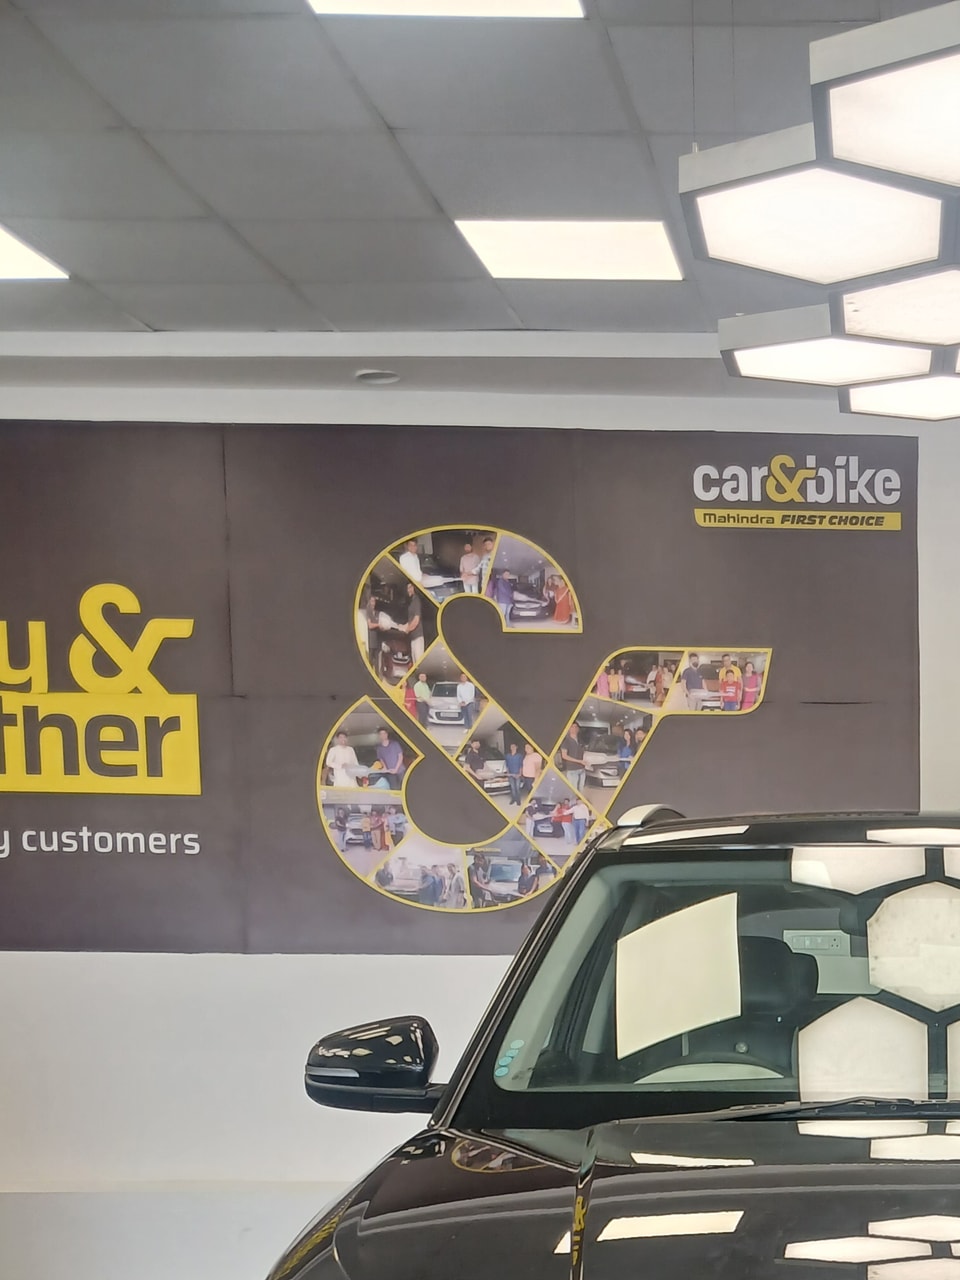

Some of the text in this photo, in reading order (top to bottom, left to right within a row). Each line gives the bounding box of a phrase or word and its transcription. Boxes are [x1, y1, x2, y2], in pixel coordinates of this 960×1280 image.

[692, 454, 901, 505] car&bike
[703, 512, 885, 527] Mahindra FIRST CHOICE
[69, 583, 195, 693] &
[21, 826, 201, 855] customers
